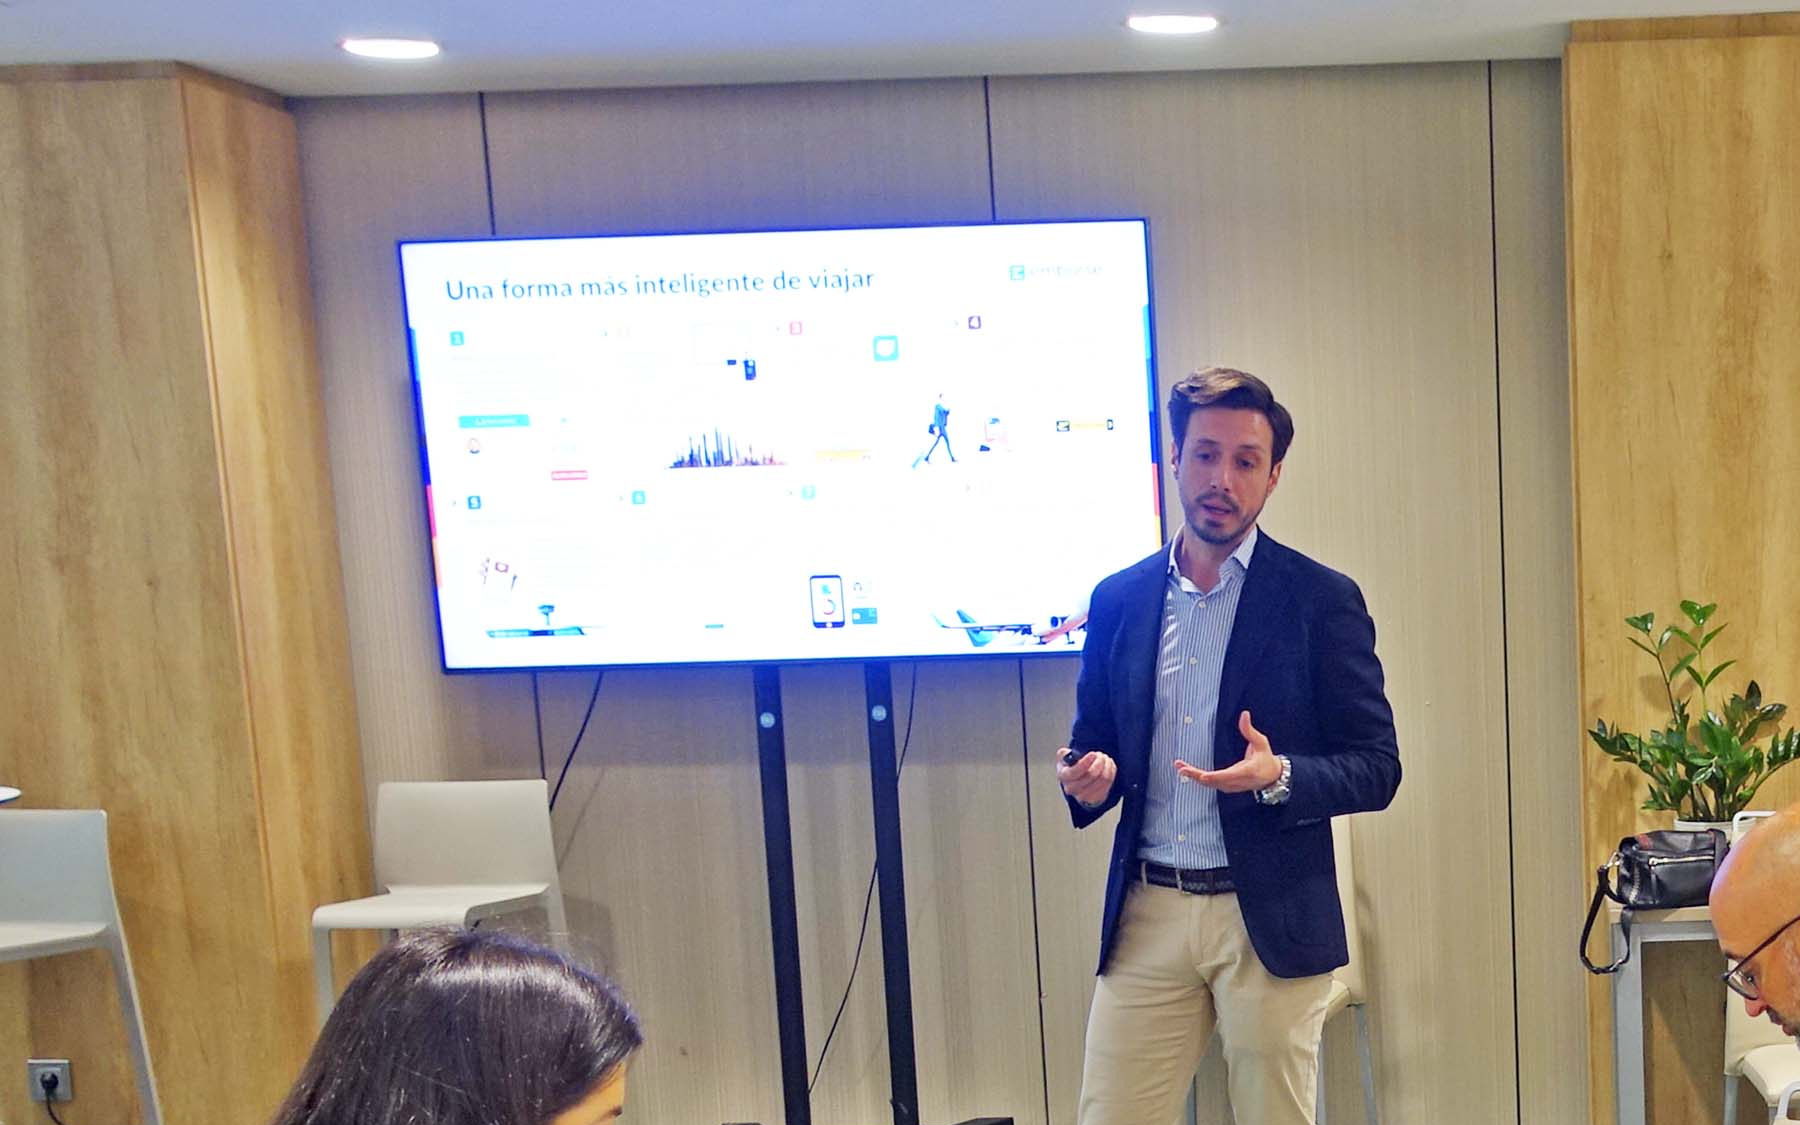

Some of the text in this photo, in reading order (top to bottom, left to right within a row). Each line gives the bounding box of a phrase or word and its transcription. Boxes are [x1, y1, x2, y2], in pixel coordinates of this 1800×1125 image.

[446, 280, 494, 301] Una
[502, 279, 572, 299] forma
[635, 273, 765, 298] inteligente
[773, 270, 801, 291] de
[809, 268, 874, 292] viajar
